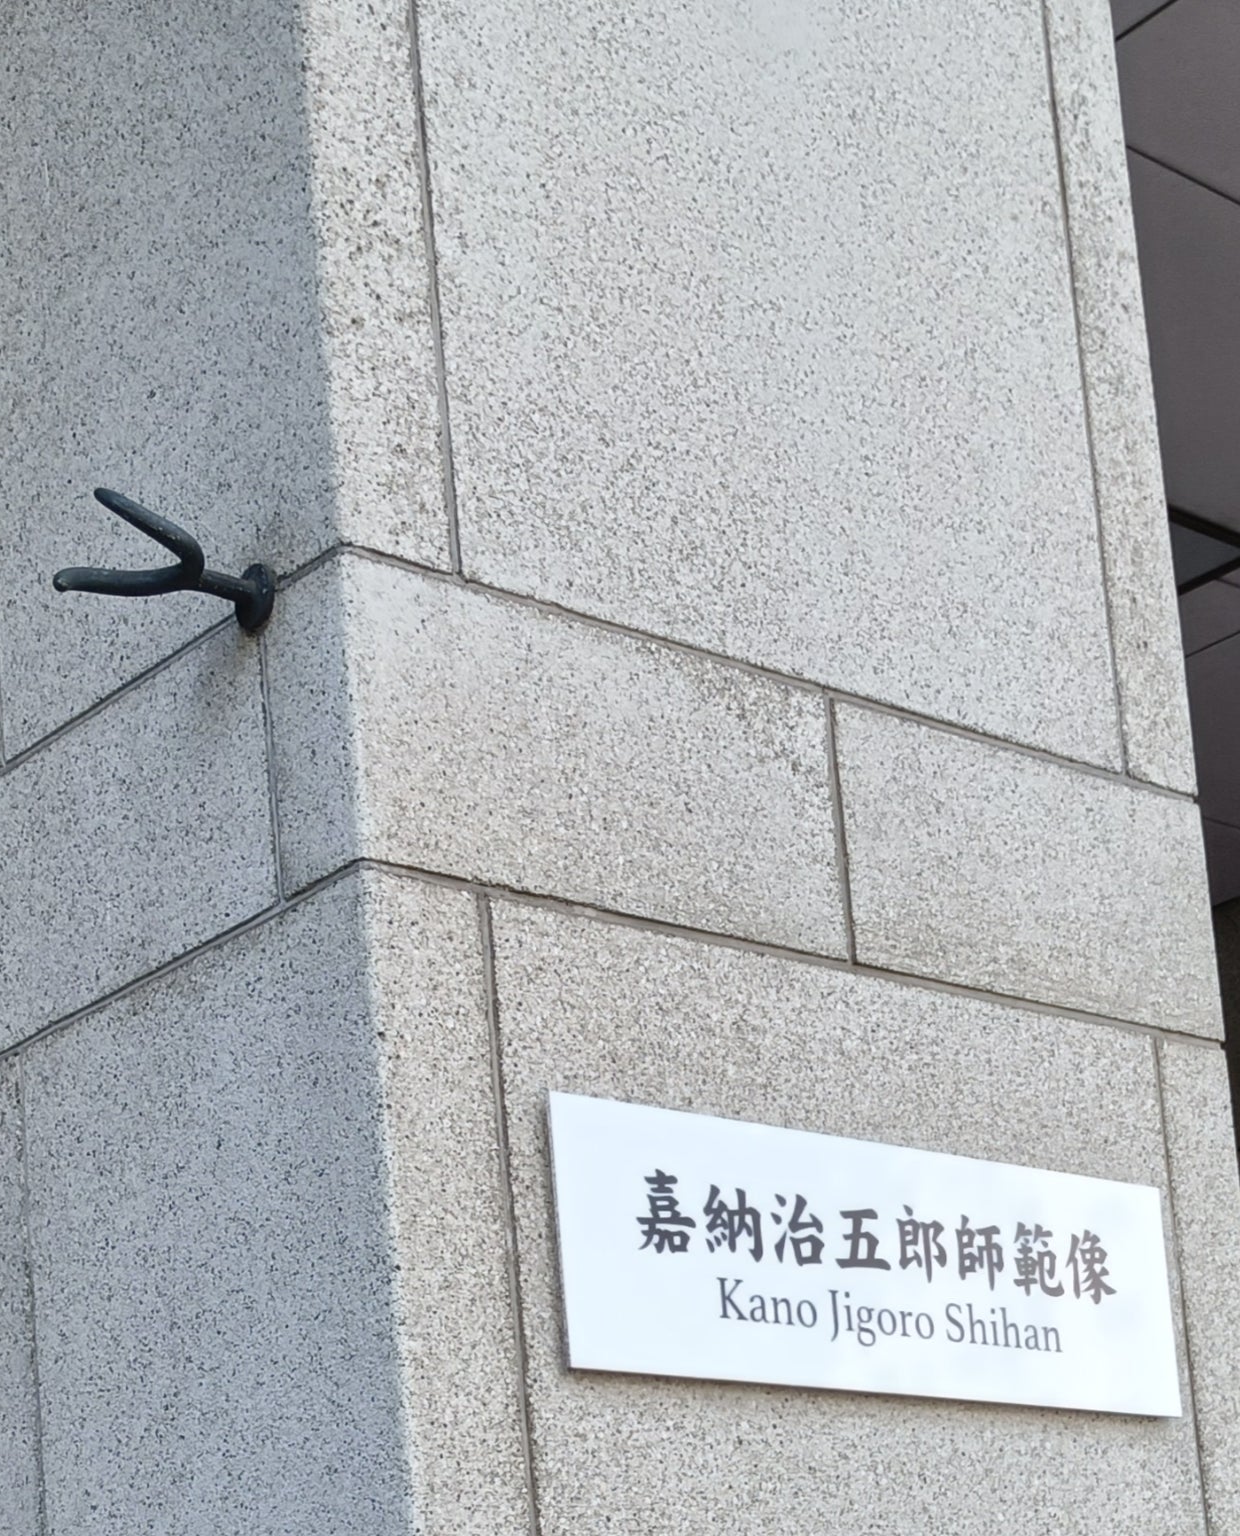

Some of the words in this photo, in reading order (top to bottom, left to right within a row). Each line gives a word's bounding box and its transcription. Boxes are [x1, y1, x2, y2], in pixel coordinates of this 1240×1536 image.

[636, 1168, 1117, 1305] 嘉納治五郎師範像
[716, 1276, 818, 1329] Kano
[829, 1289, 935, 1347] Jigoro
[945, 1302, 1063, 1354] Shihan
